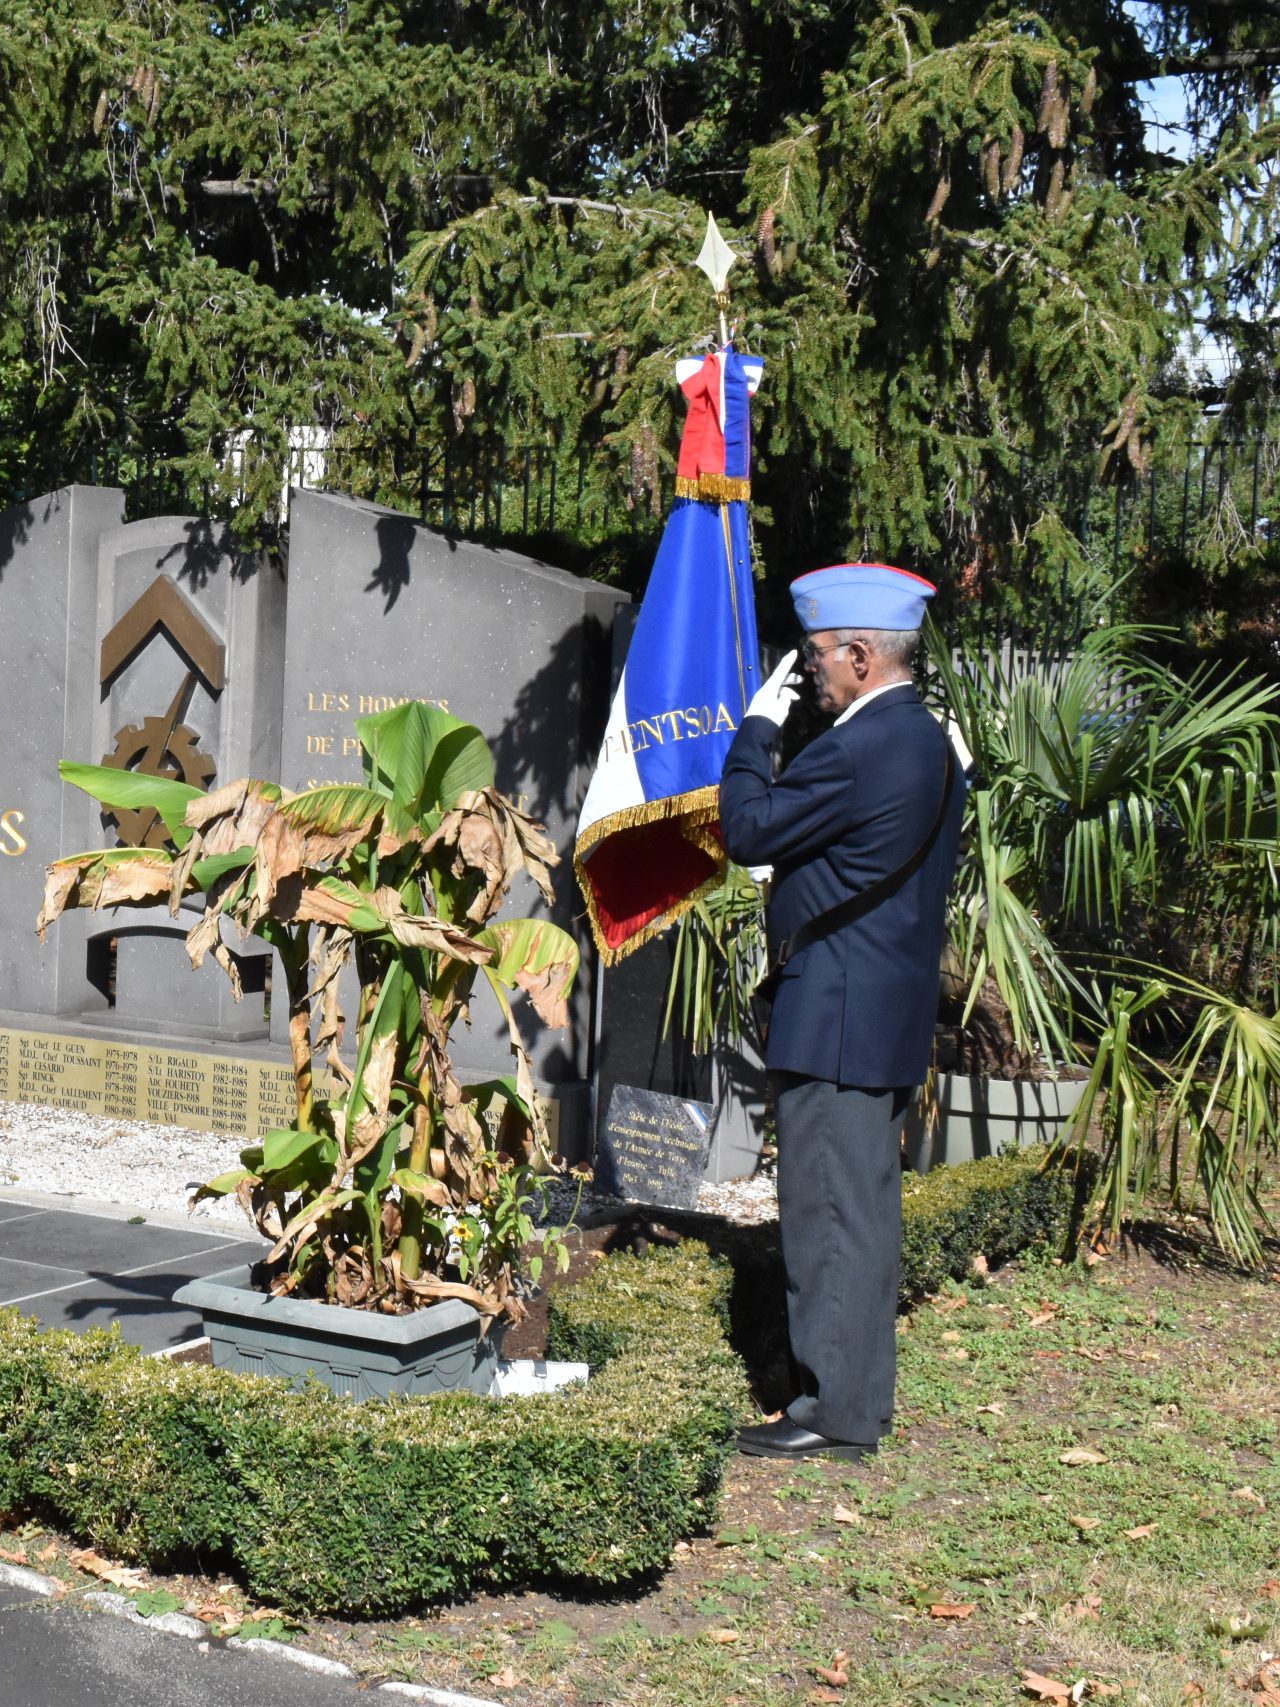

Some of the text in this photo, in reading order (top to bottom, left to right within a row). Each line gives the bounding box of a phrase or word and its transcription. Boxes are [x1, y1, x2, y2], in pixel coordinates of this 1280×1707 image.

[308, 693, 350, 712] LES
[307, 735, 334, 755] DE
[19, 1037, 85, 1054] Sgt Chef LE GUEN
[43, 1051, 58, 1062] Chef
[62, 1054, 101, 1068] TOUSSAINT
[106, 1049, 138, 1061] 1975-1978
[19, 1060, 64, 1073] Adt CESARIO
[105, 1060, 137, 1072] 1976-1979
[167, 1056, 198, 1069] RIGAUD
[18, 1069, 55, 1083] Sgt RINCK
[167, 1067, 207, 1082] HARISTOY
[213, 1063, 248, 1076] 1981-1984
[259, 1068, 270, 1080] Sgt
[105, 1071, 137, 1084] 1977-1980
[213, 1074, 248, 1087] 1982-1985
[105, 1082, 136, 1094] 1978-1981
[165, 1079, 201, 1092] FOUHETY
[213, 1085, 248, 1098] 1983-1986
[42, 1084, 56, 1094] Chef
[61, 1087, 102, 1101] LALLEMENT
[147, 1087, 200, 1103] VOUZIERS-1918
[18, 1093, 87, 1109] Adt Chef GADEAUD
[104, 1093, 136, 1106] 1979-1982
[212, 1096, 247, 1109] 1984-1987
[104, 1105, 136, 1118] 1980-1983
[147, 1099, 211, 1117] VILLE D'ISSOIRE
[258, 1103, 287, 1115] Général
[147, 1111, 178, 1123] Adt VAL
[212, 1108, 247, 1122] 1985-1988
[258, 1115, 270, 1125] Adt
[649, 1116, 658, 1125] de
[211, 1120, 246, 1132] 1986-1989
[613, 1139, 622, 1150] de
[655, 1149, 665, 1158] de
[668, 1152, 688, 1164] Terre
[658, 1165, 677, 1177] Tulle
